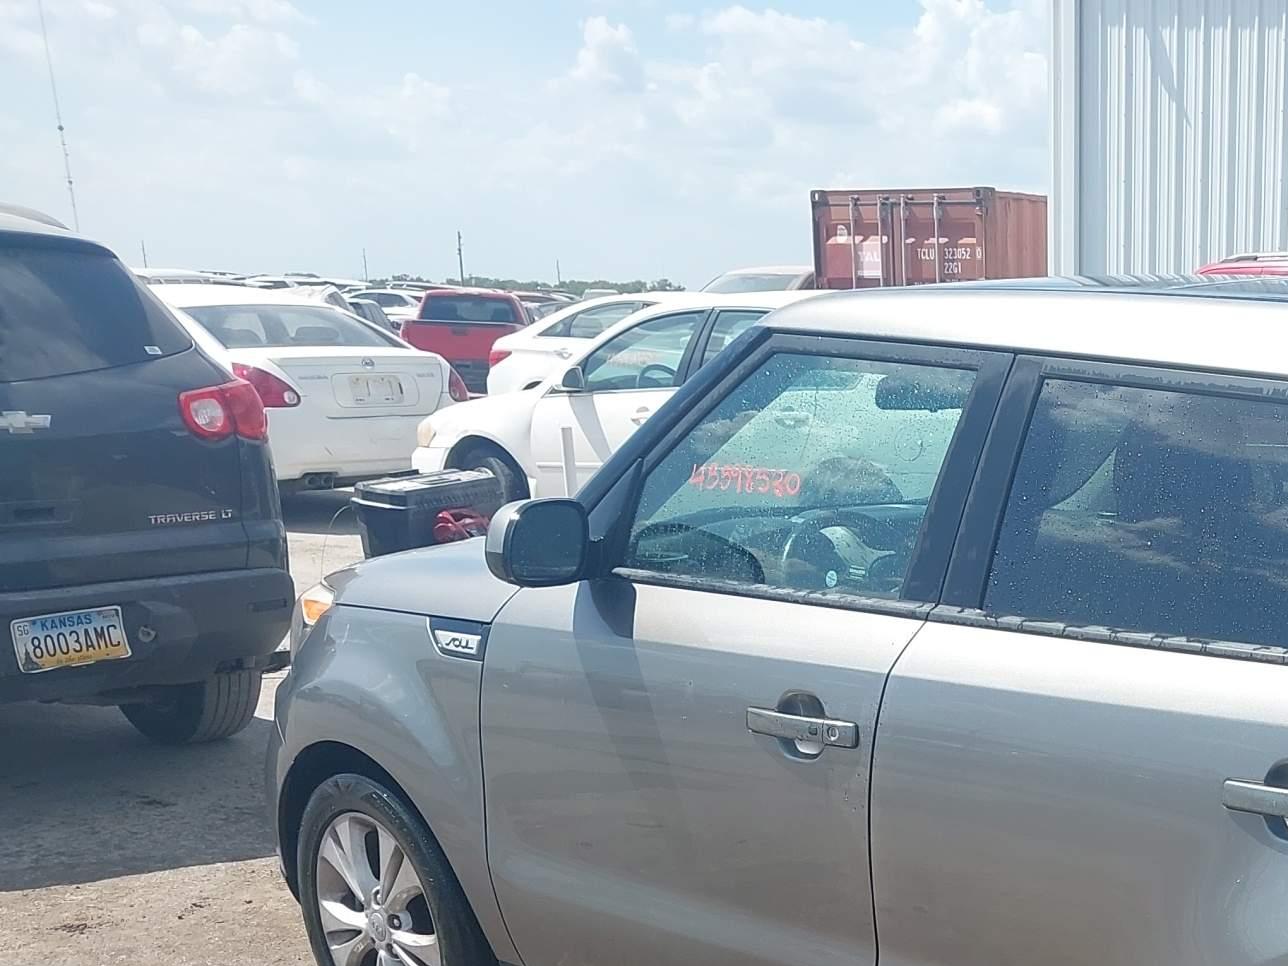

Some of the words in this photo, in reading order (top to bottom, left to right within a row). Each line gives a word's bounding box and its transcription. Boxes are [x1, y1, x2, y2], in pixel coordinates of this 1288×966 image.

[917, 248, 935, 260] TCLU
[944, 248, 971, 260] 323052
[944, 262, 962, 274] 22G1
[148, 510, 217, 525] TRAVERSE
[221, 508, 233, 519] LT
[40, 613, 93, 632] KANSAS
[16, 624, 29, 637] SG
[31, 624, 121, 659] 8003AMC
